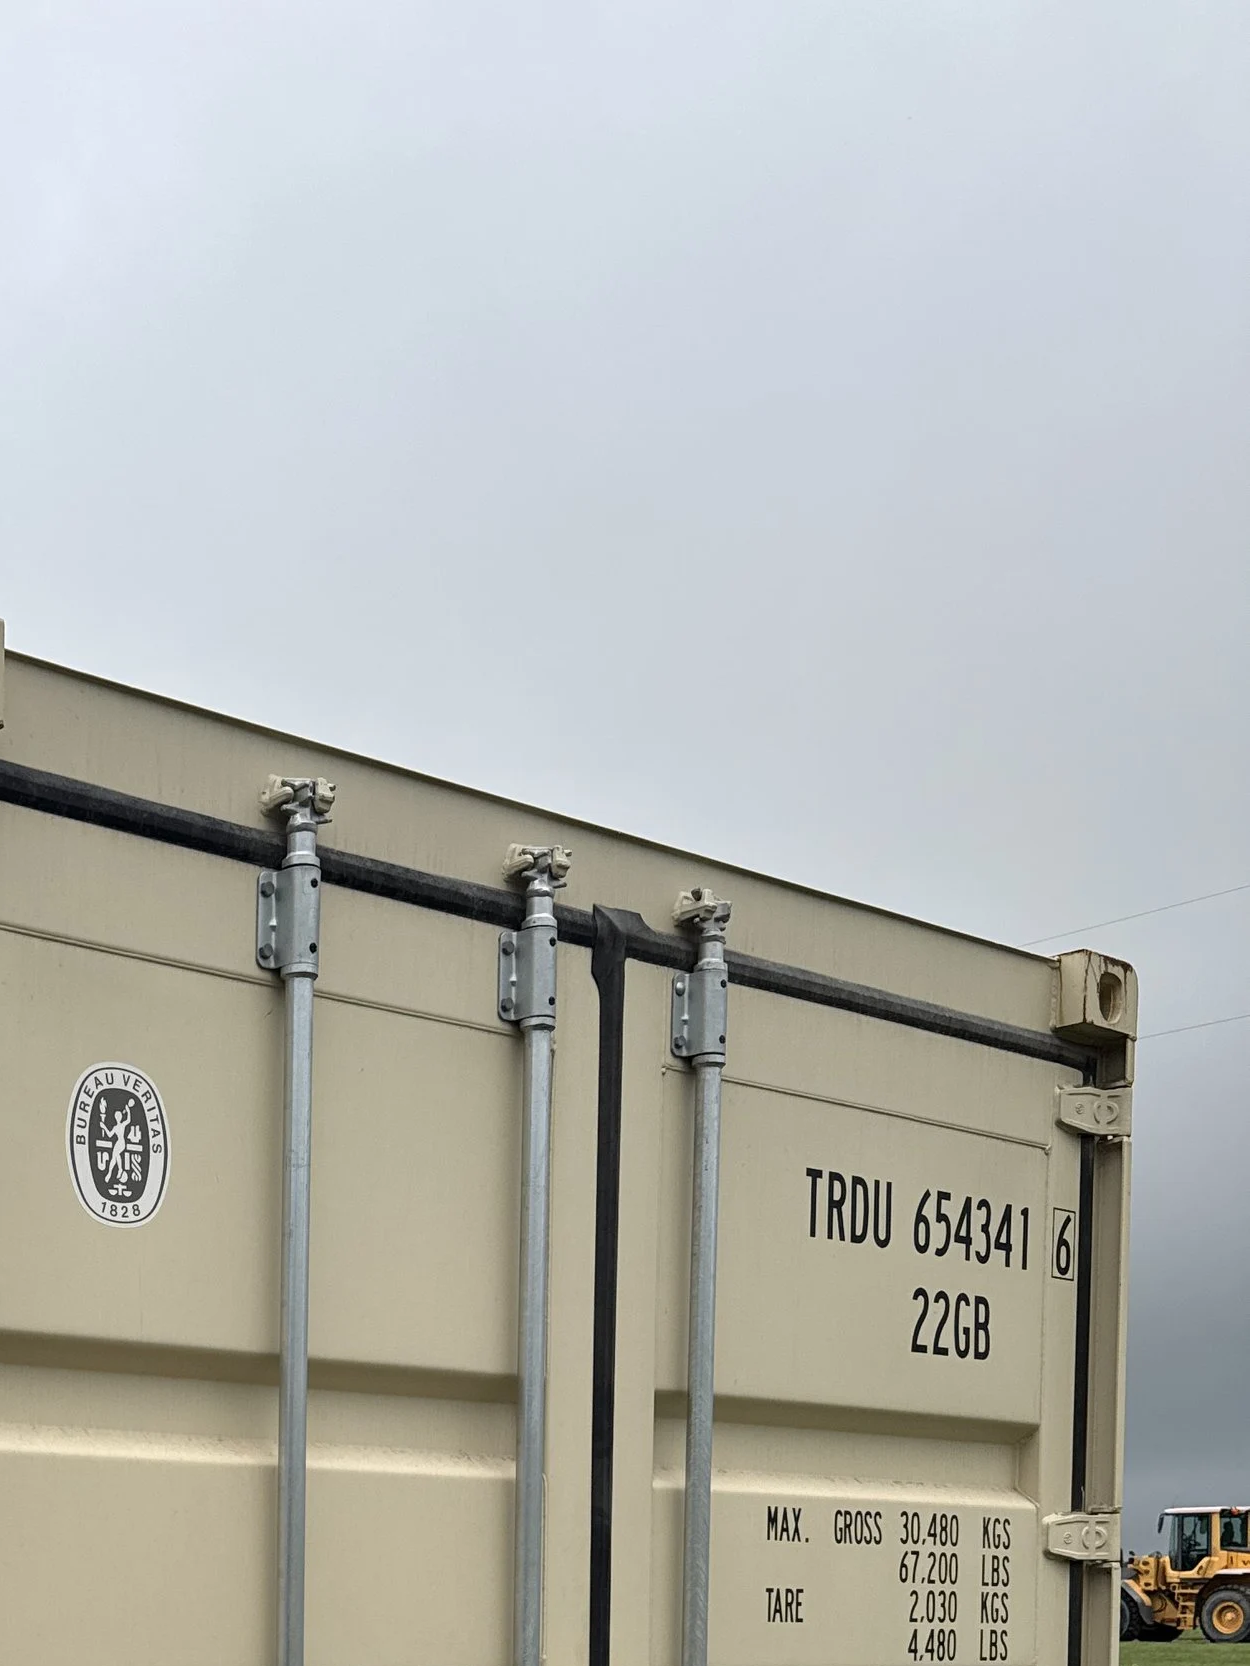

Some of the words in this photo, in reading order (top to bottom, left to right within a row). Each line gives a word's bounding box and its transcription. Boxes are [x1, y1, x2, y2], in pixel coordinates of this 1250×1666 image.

[76, 1073, 114, 1145] BUREAU
[122, 1075, 162, 1154] VERITAS
[101, 1201, 141, 1218] 1828
[806, 1167, 892, 1249] TRDU
[913, 1188, 1031, 1271] 654341
[1055, 1214, 1072, 1276] 6
[911, 1287, 991, 1361] 22GB
[766, 1506, 810, 1543] MAX.
[834, 1510, 883, 1545] GROSS
[900, 1511, 959, 1547] 30,480
[982, 1516, 1011, 1550] KGS
[899, 1551, 959, 1584] 67,200
[981, 1554, 1010, 1587] LBS
[766, 1588, 804, 1623] TARE
[909, 1590, 958, 1623] 2,030
[980, 1592, 1009, 1624] KGS
[907, 1629, 957, 1661] 4,480
[980, 1629, 1008, 1661] LBS
